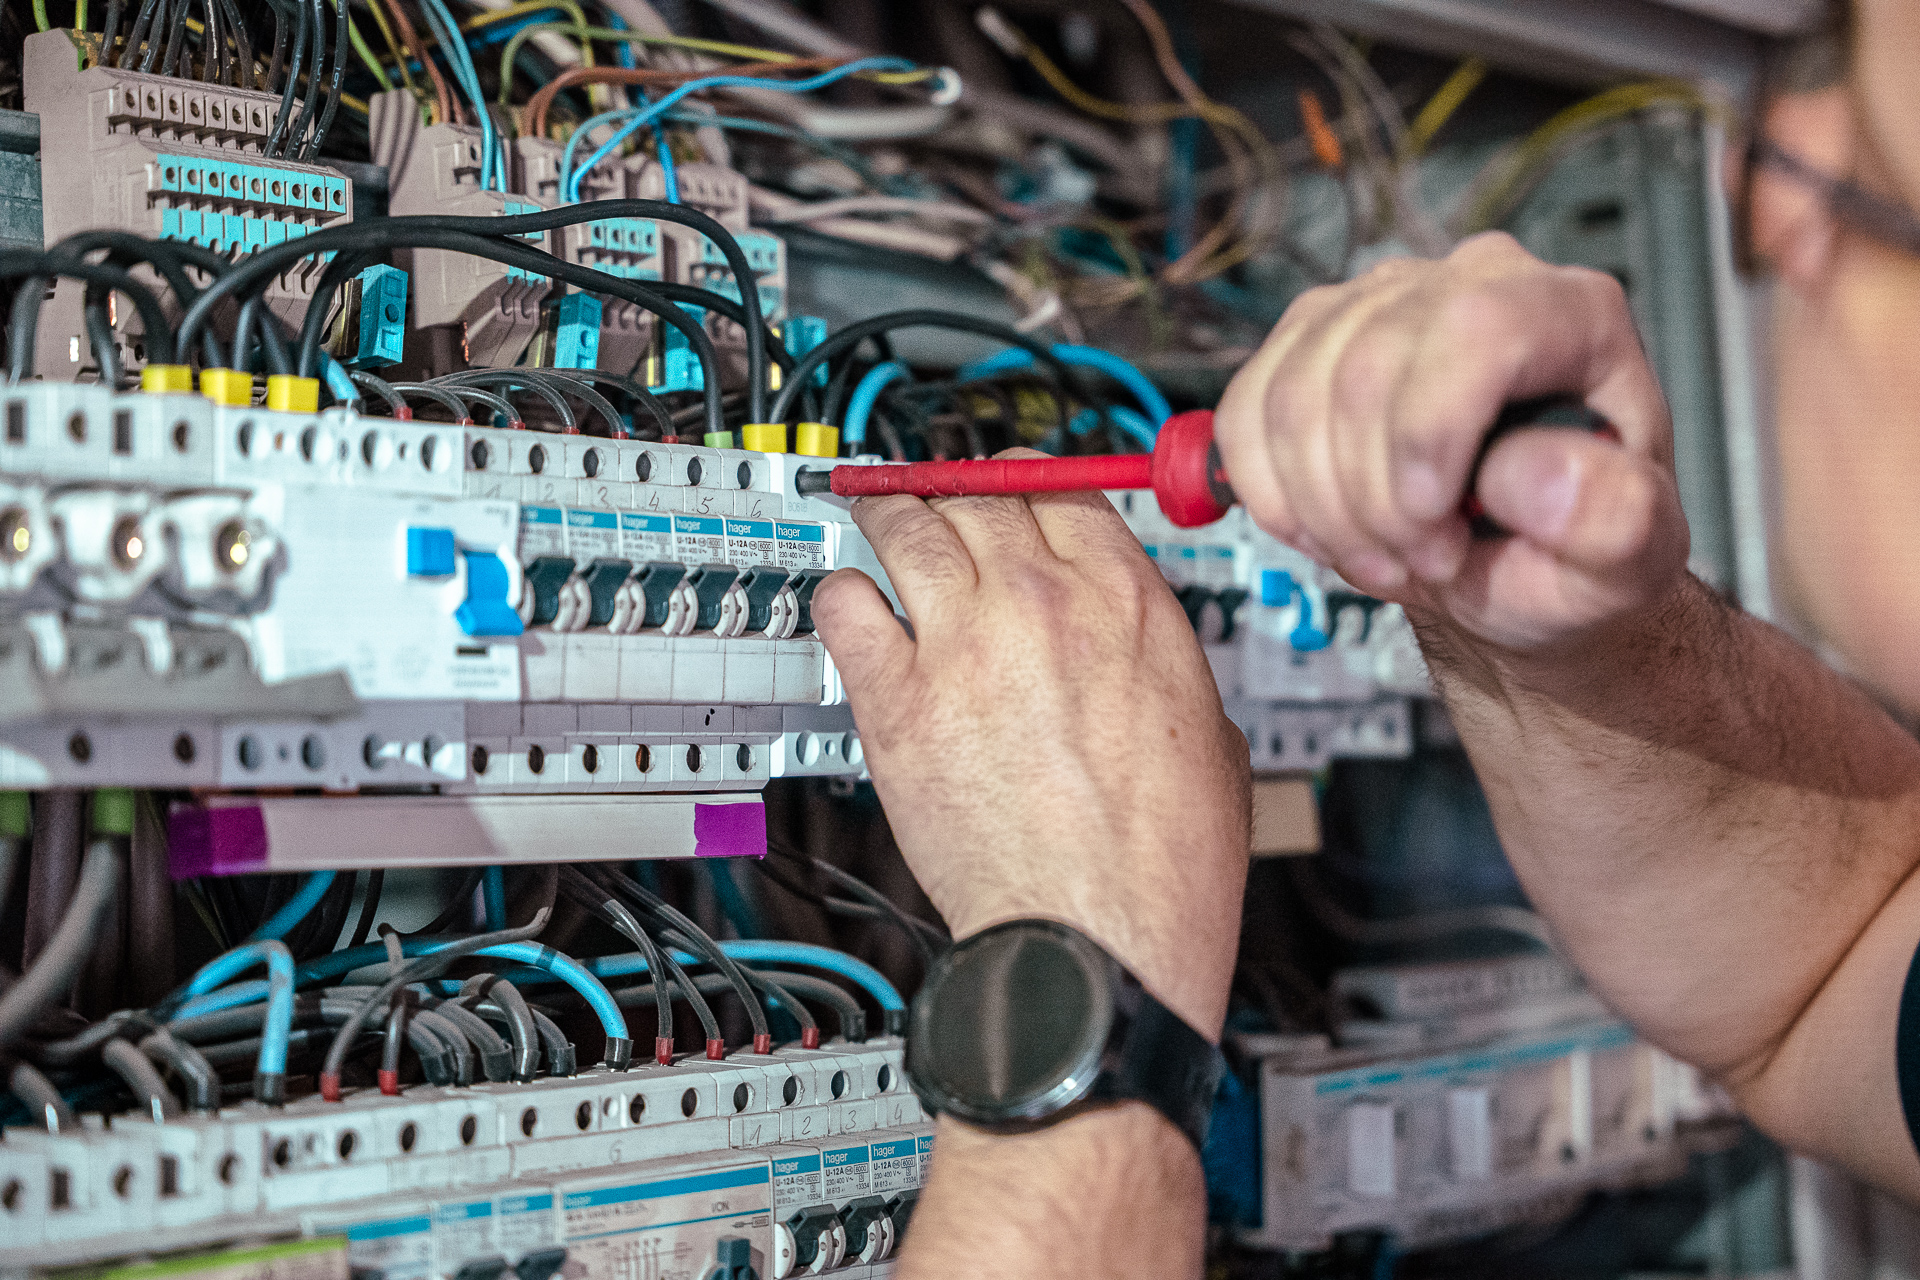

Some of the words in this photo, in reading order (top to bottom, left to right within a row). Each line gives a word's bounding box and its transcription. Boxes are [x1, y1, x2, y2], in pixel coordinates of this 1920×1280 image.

[542, 483, 555, 502] 2
[648, 491, 660, 512] 4
[697, 497, 714, 514] 5
[750, 499, 762, 518] 6
[676, 517, 701, 532] hager
[728, 521, 752, 536] hager
[777, 524, 801, 539] hager
[676, 536, 697, 545] U-12A
[728, 539, 748, 547] U-12A
[778, 541, 798, 550] U-12A
[893, 1103, 903, 1122] 4
[801, 1115, 812, 1135] 2
[844, 1110, 857, 1130] 3
[750, 1124, 762, 1145] 1
[873, 1145, 896, 1158] hager
[919, 1138, 936, 1151] hag
[824, 1152, 848, 1164] hager
[919, 1153, 933, 1163] U-12
[774, 1161, 799, 1174] hager
[825, 1167, 845, 1177] U-12A
[873, 1161, 892, 1171] U-12A
[775, 1176, 795, 1187] U-12A
